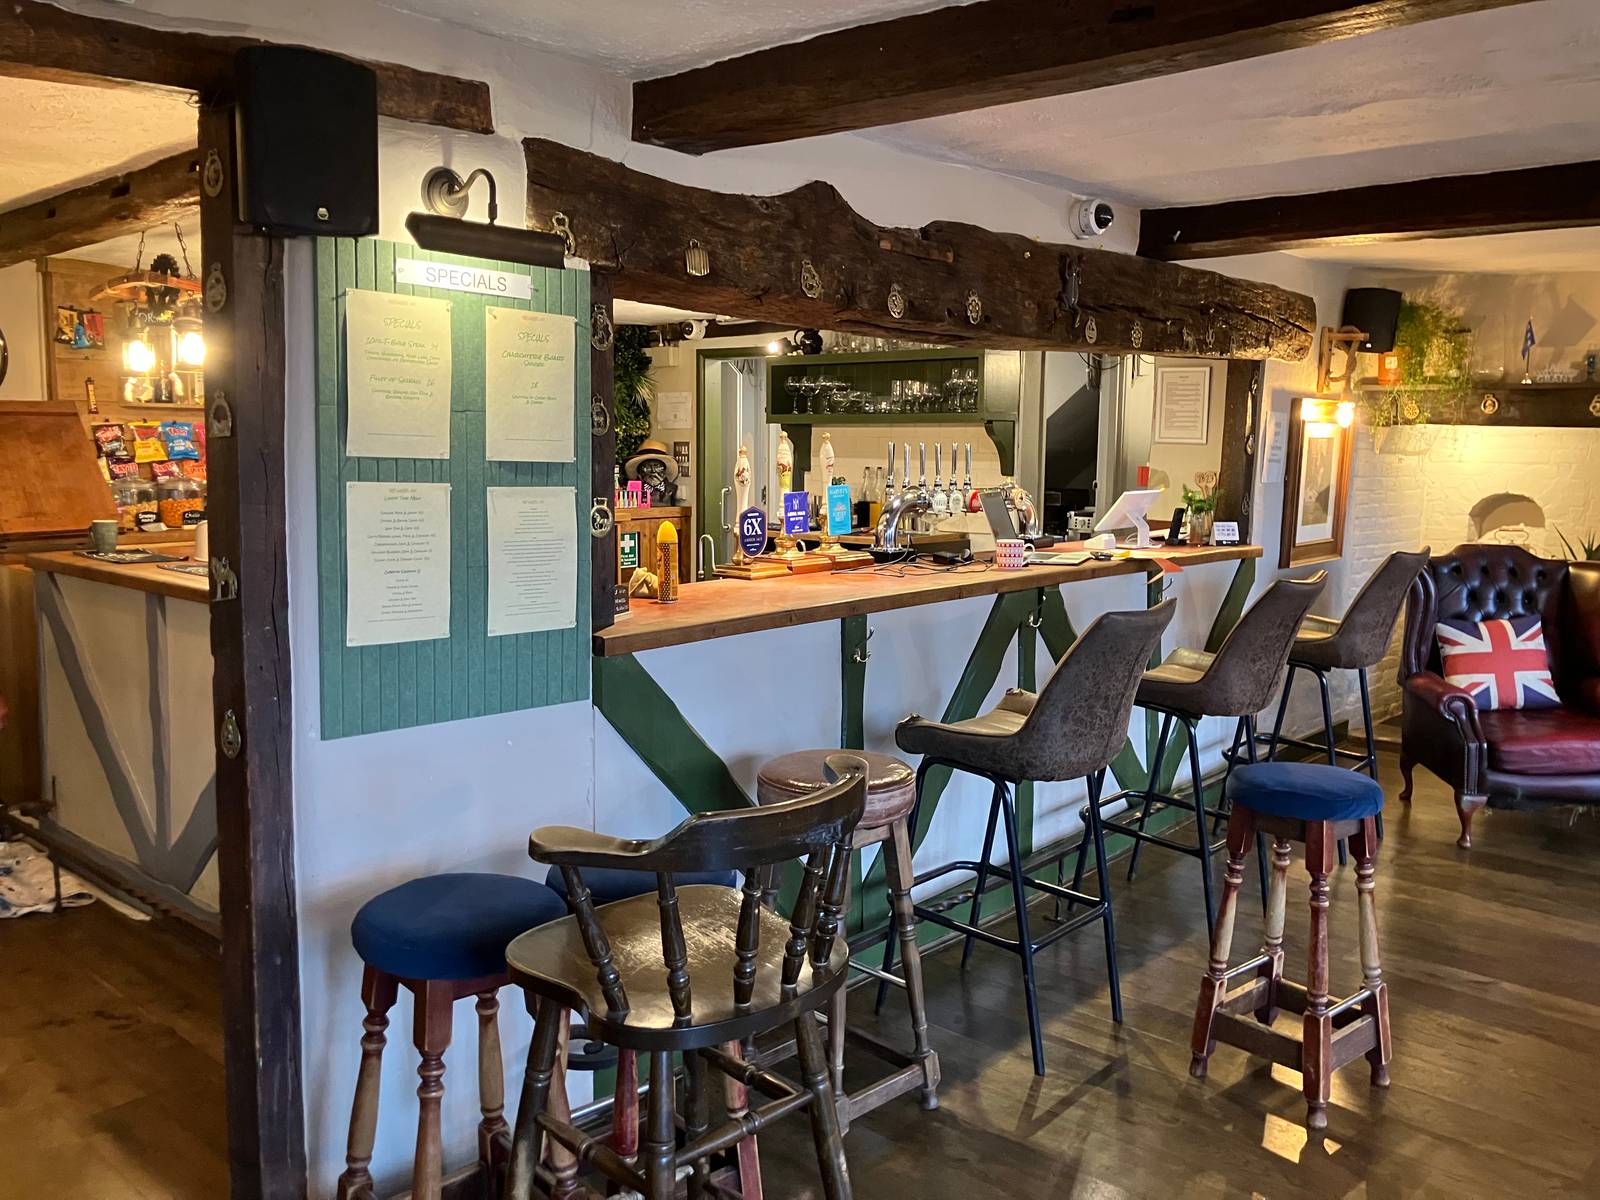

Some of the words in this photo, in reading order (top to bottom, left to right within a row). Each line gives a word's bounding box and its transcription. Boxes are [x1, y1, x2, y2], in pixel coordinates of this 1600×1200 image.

[425, 266, 507, 292] SPECIALS
[383, 317, 422, 329] SPECIALS
[517, 332, 550, 343] SPECIALS
[743, 517, 763, 536] 6X
